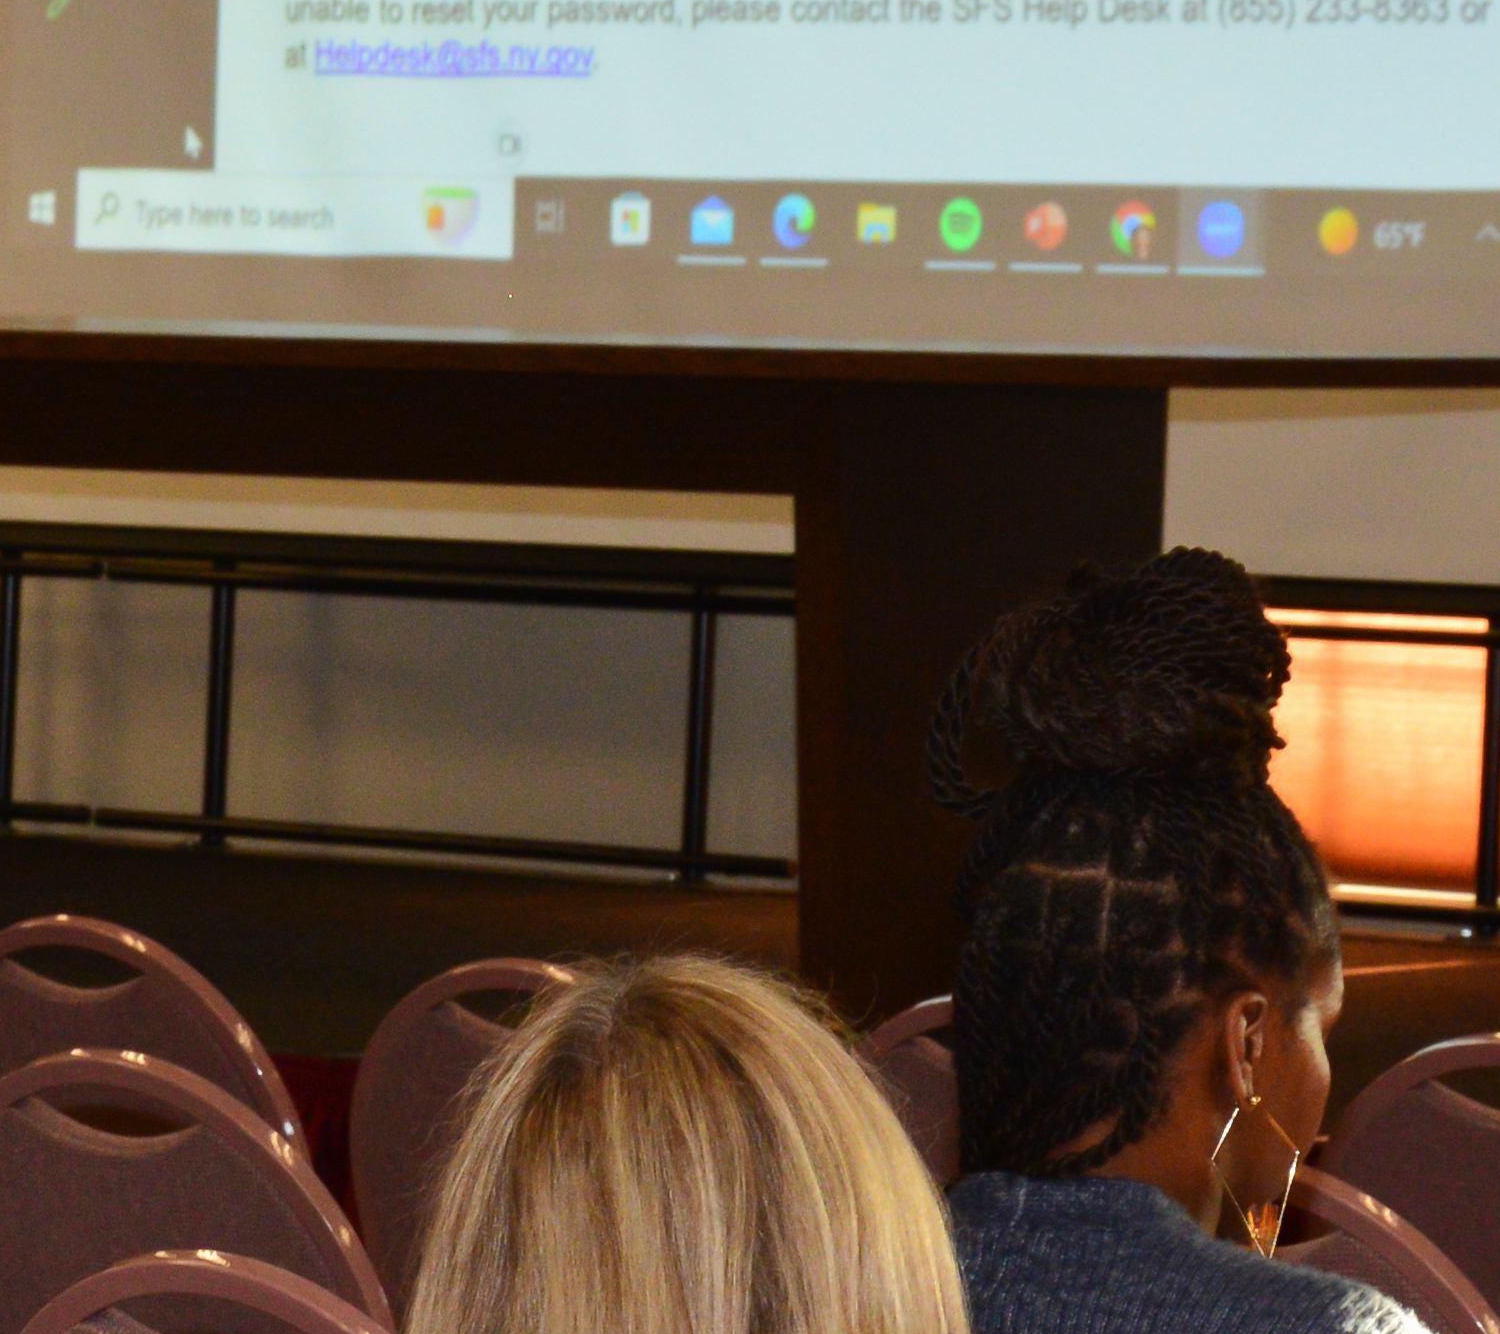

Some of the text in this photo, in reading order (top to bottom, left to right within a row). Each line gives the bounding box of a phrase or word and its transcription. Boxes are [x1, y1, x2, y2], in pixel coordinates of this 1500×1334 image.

[482, 0, 539, 29] your
[285, 43, 306, 69] at
[136, 200, 335, 230] Type here to search
